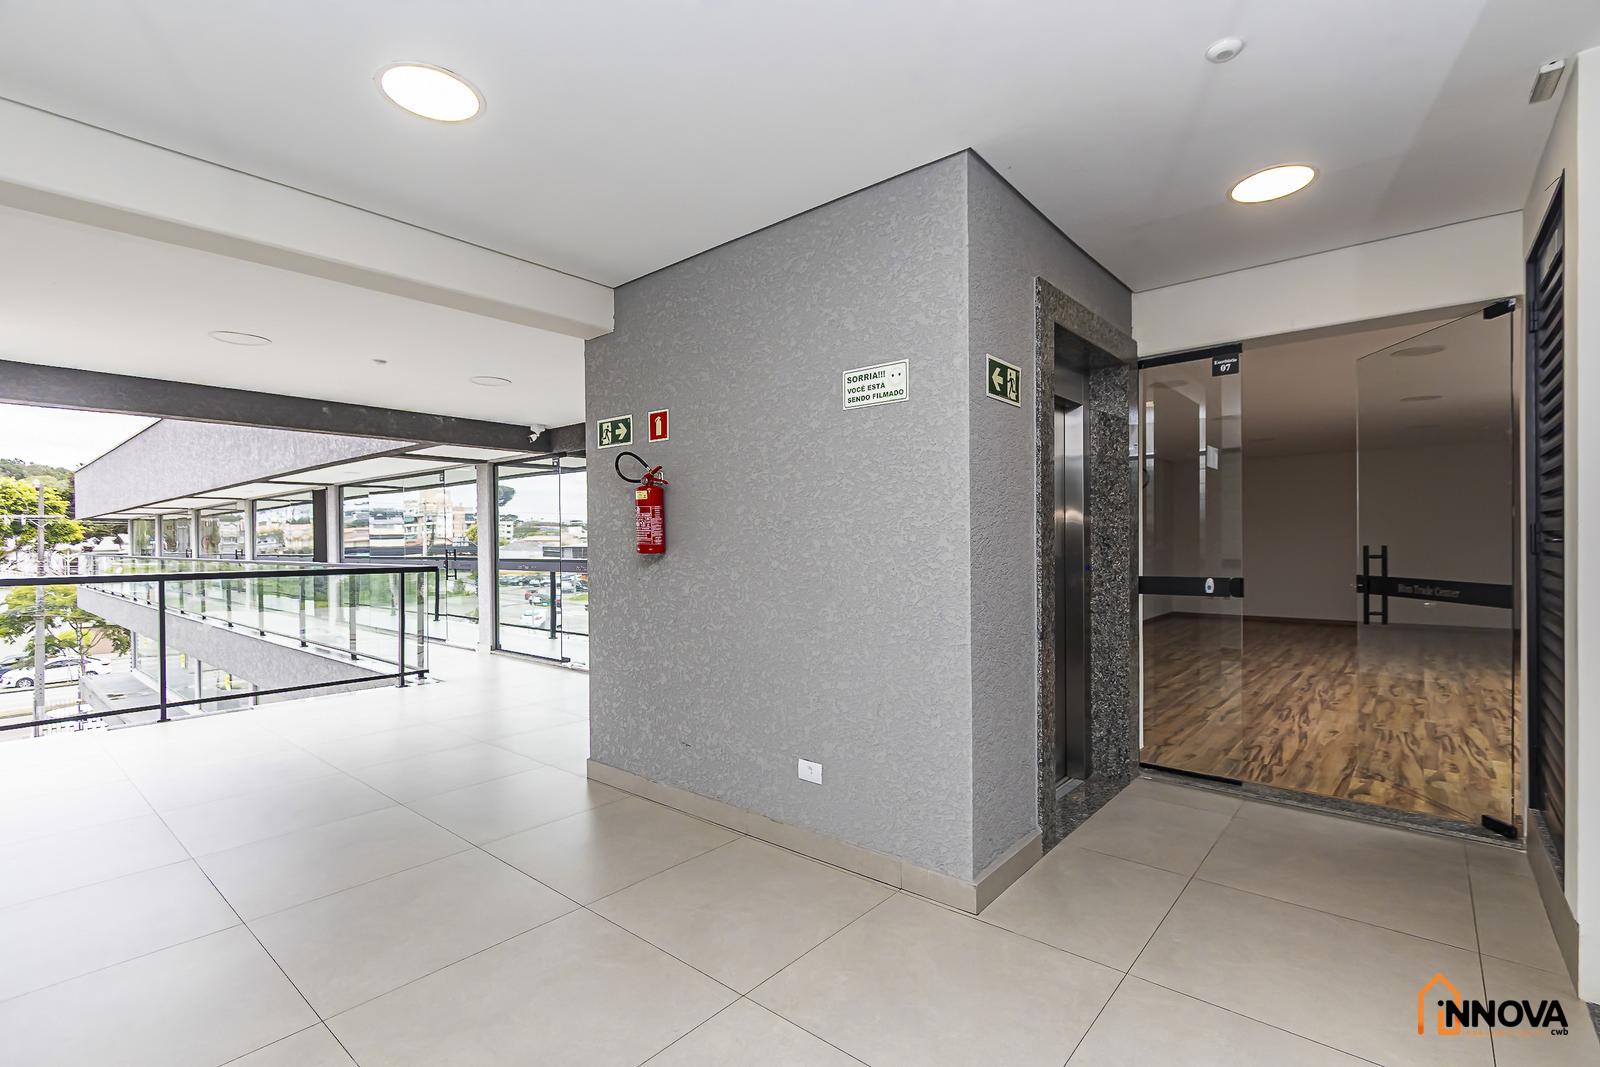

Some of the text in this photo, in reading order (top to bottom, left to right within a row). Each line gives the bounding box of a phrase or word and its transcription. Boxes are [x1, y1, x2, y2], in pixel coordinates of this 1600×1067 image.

[1220, 363, 1231, 372] 07
[847, 370, 886, 384] SORRIA!!!
[847, 388, 904, 404] SENDO FILMADO
